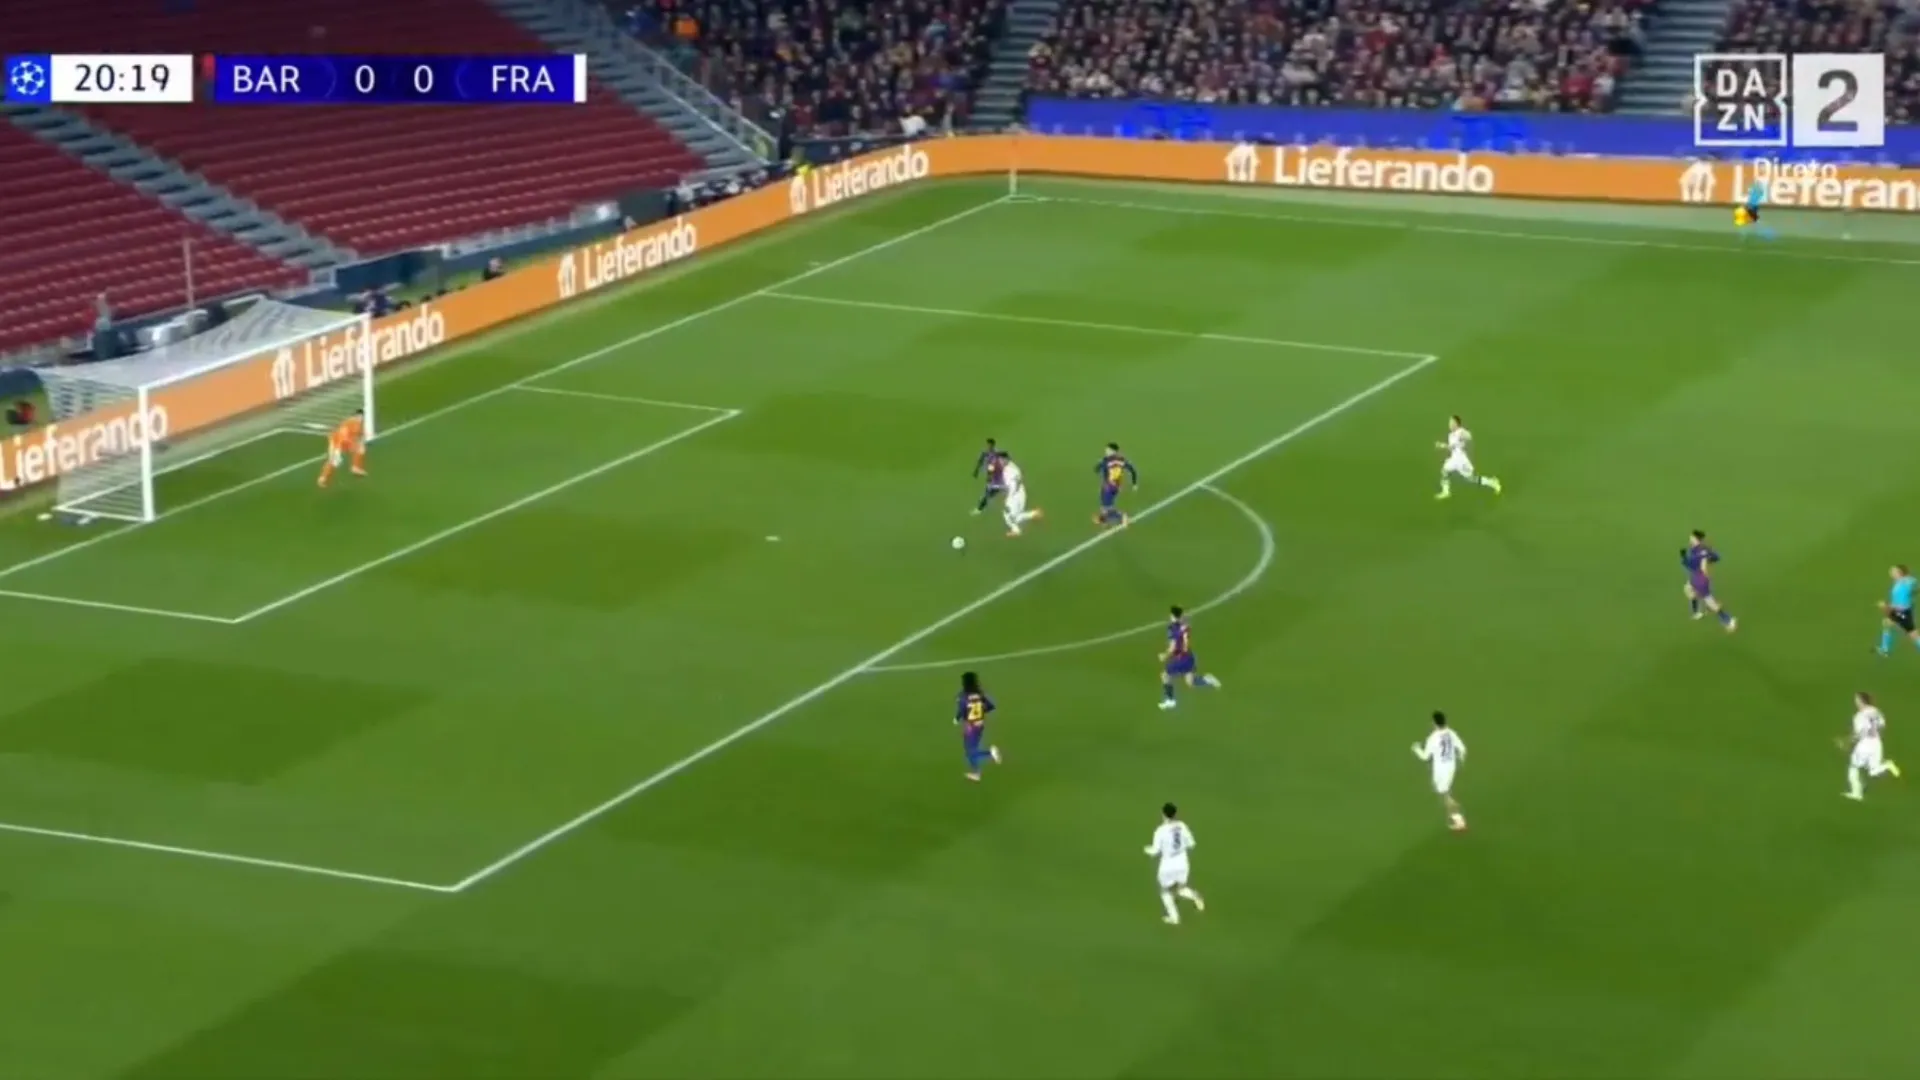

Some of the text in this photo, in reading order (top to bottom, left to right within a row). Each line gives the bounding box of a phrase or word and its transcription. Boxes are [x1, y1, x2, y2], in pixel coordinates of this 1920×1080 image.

[812, 143, 930, 208] Lieferando
[1273, 145, 1495, 194] Lieferando
[1733, 164, 1920, 210] Lieferan
[583, 215, 697, 290] Lieferando
